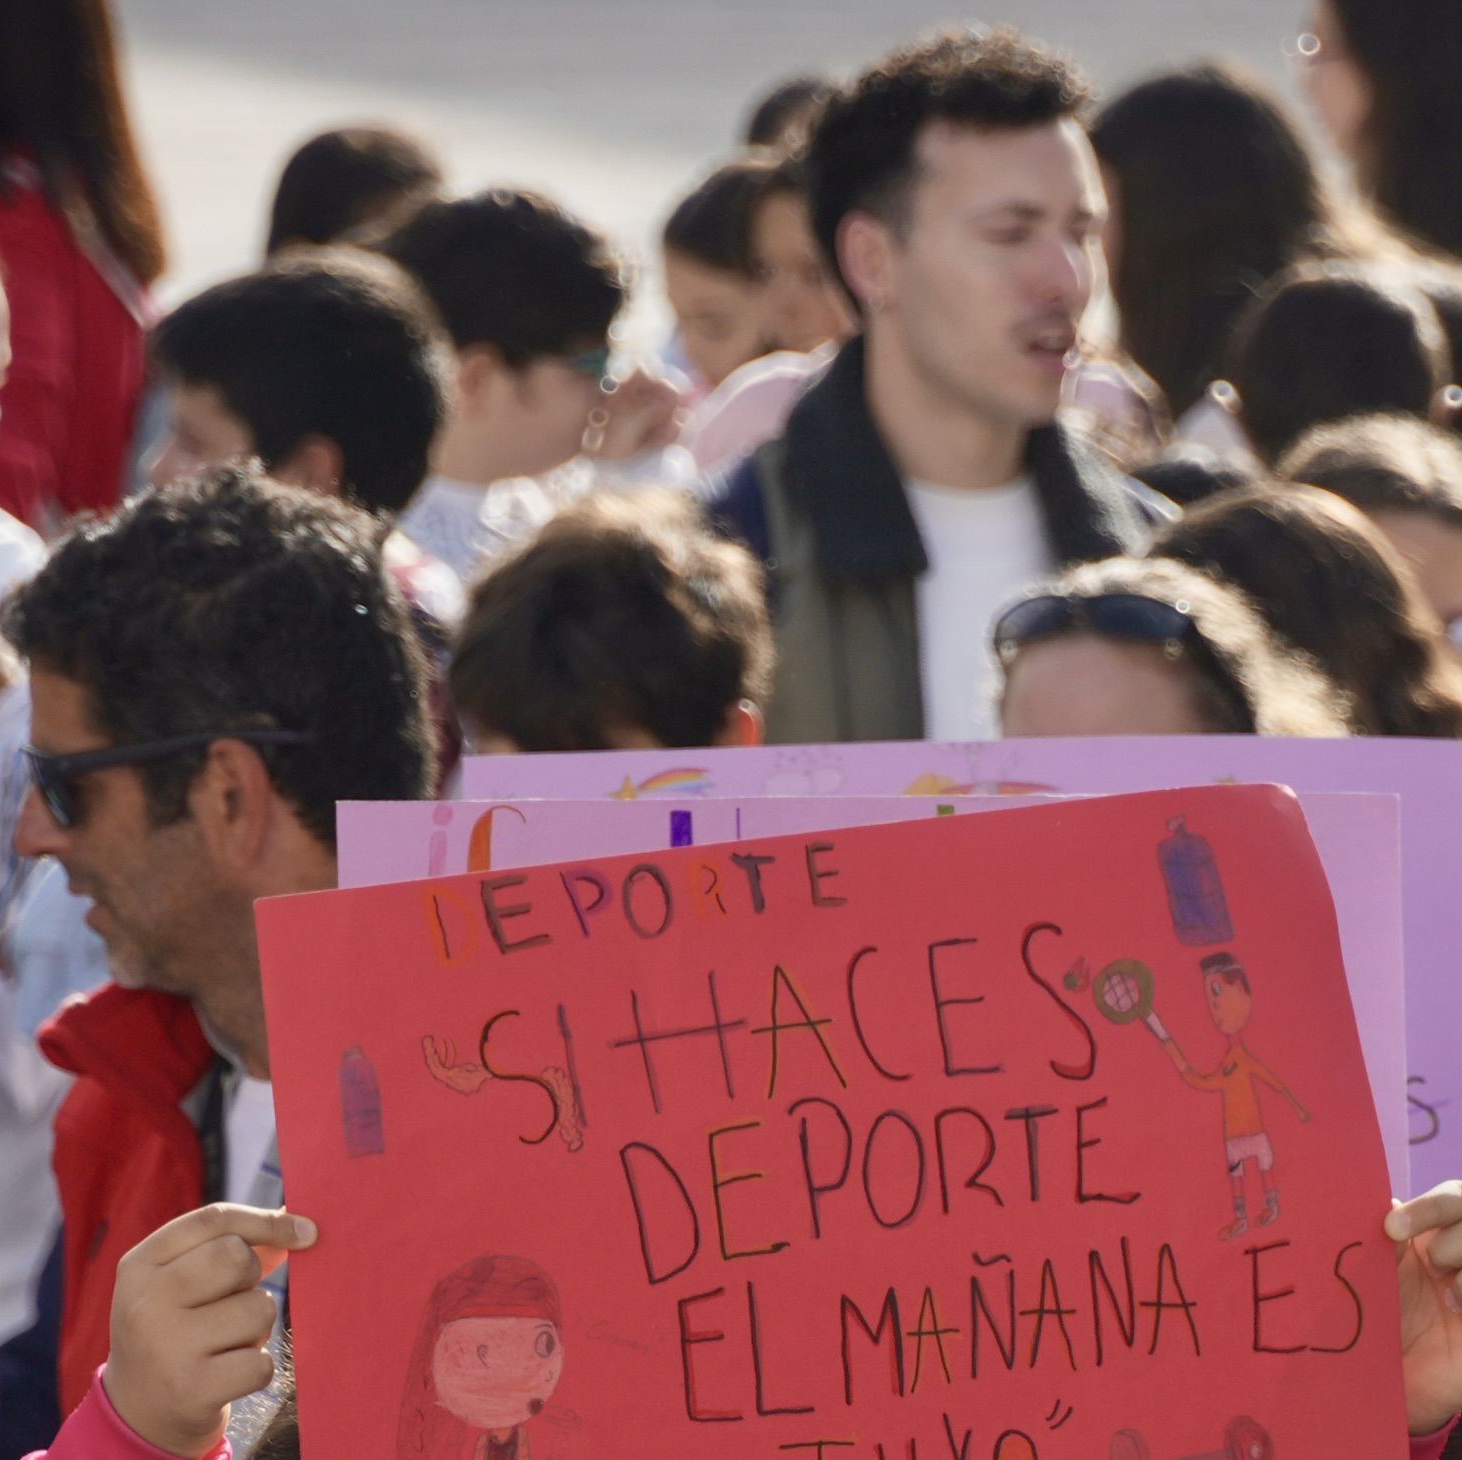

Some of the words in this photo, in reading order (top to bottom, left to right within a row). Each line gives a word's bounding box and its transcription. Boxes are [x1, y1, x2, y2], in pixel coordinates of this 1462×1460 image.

[424, 842, 848, 965] DEPORTE
[609, 921, 1097, 1114] HACES
[619, 1096, 1141, 1285] DEPORTE
[677, 1280, 815, 1423] EL
[840, 1235, 1201, 1406] MAÑANA
[1243, 1240, 1366, 1355] ES
